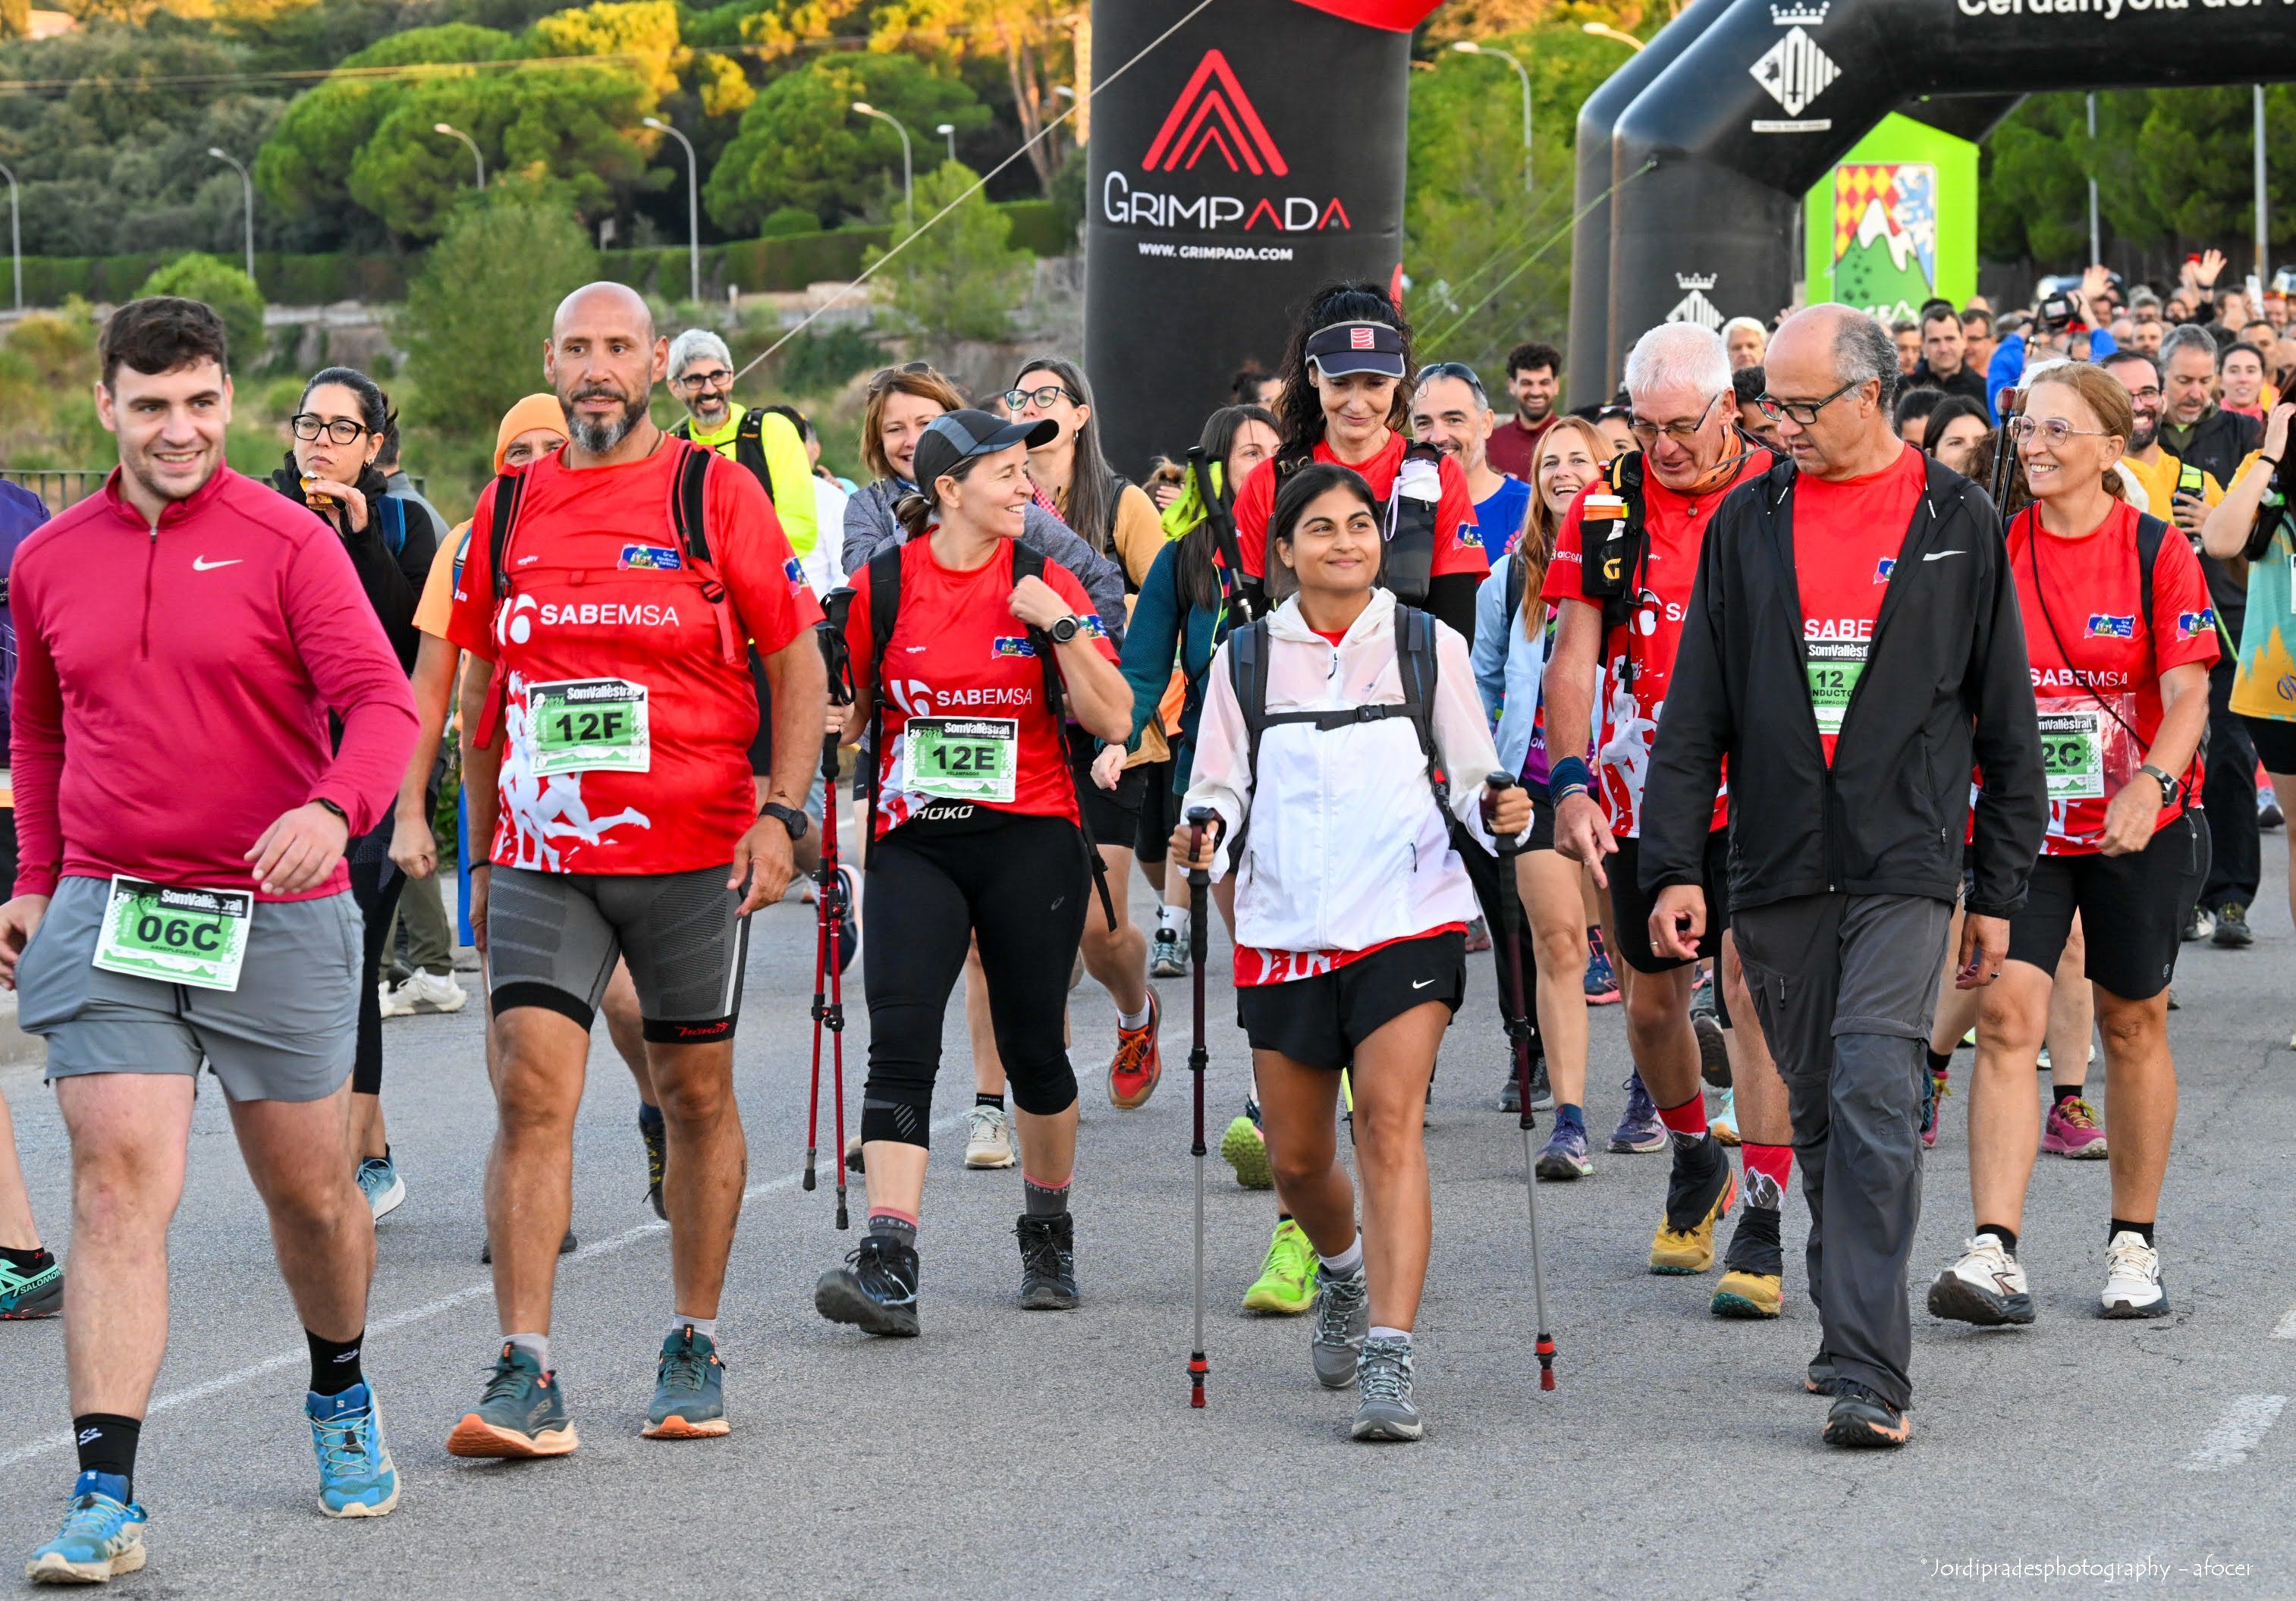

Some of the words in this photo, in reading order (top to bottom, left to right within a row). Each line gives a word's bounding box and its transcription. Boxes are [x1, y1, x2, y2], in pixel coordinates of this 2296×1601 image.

[1104, 171, 1350, 231] GRIMPADA
[540, 604, 680, 627] SABEMSA
[1804, 618, 1877, 638] SABE
[1816, 670, 1844, 688] 12
[2031, 669, 2128, 686] SABEMSA
[936, 688, 1032, 707] SABEMSA
[1811, 689, 1853, 697] NDUCTO
[556, 711, 623, 742] 12F
[933, 745, 996, 771] 12E
[137, 915, 221, 951] 06C
[20, 1268, 61, 1295] SALOMON
